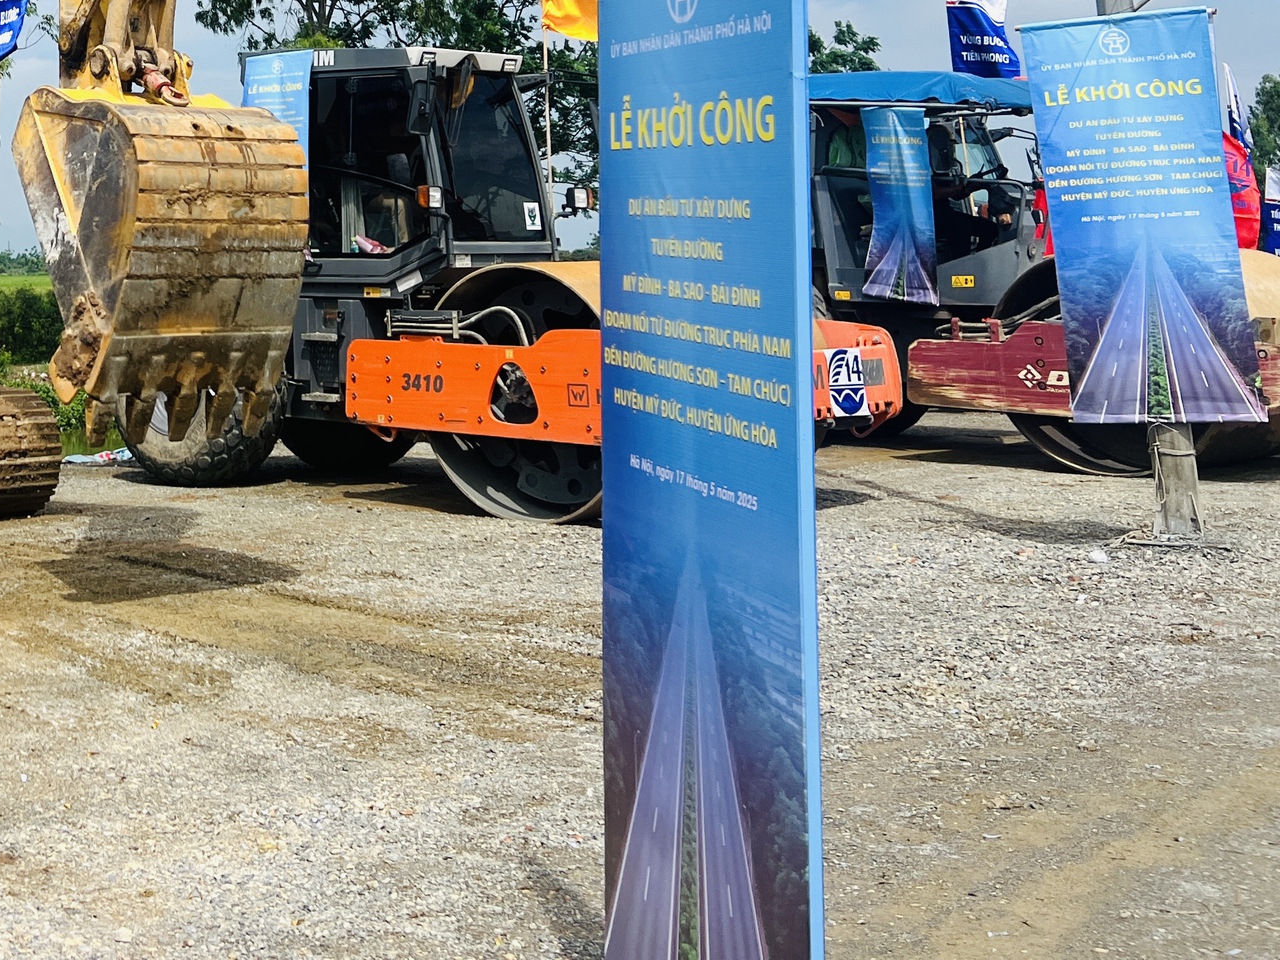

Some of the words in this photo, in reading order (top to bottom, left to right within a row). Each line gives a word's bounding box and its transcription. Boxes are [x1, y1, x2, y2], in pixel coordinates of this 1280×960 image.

[611, 39, 620, 58] ỦY
[622, 41, 638, 56] BAN
[640, 33, 661, 52] NHÂN
[664, 30, 681, 48] DÂN
[683, 25, 713, 44] THÀNH
[715, 14, 735, 39] PHỐ
[737, 14, 751, 35] HÀ
[754, 10, 771, 34] NỘI
[1054, 62, 1071, 71] BAN
[1117, 53, 1145, 64] THÀNH
[1147, 50, 1165, 61] PHỐ
[1167, 50, 1179, 60] HÀ
[1180, 50, 1197, 60] NỘI
[1044, 83, 1070, 107] LỄ
[1075, 79, 1131, 103] KHỞI
[1135, 78, 1202, 99] CÔNG
[610, 95, 632, 150] LỄ
[638, 93, 692, 148] KHỞI
[699, 91, 775, 147] CÔNG
[1113, 146, 1126, 154] BA
[1128, 144, 1147, 153] SAO
[1198, 155, 1221, 164] NAM
[1105, 174, 1141, 184] HƯƠNG
[1143, 173, 1162, 181] SƠN
[1170, 172, 1190, 180] TAM
[629, 197, 642, 220] DỰ
[644, 196, 656, 216] ÁN
[658, 194, 678, 217] ĐẦU
[679, 197, 694, 217] TƯ
[696, 196, 715, 218] XÂY
[718, 197, 751, 224] DỰNG
[1061, 192, 1092, 202] HUYỆN
[684, 237, 723, 261] ĐƯỜNG
[623, 272, 637, 292] MỸ
[638, 273, 662, 295] ĐÌNH
[668, 279, 681, 298] BA
[683, 281, 704, 301] SAO
[731, 283, 761, 309] ĐÍNH
[604, 308, 631, 333] (ĐOẠN
[633, 310, 649, 333] NỐI
[650, 315, 663, 335] TỪ
[665, 319, 702, 343] ĐƯỜNG
[703, 326, 731, 352] TRỤC
[733, 329, 760, 353] PHÍA
[762, 335, 791, 359] NAM
[402, 373, 444, 393] 3410
[604, 343, 621, 366] ĐẾN
[623, 351, 656, 375] ĐƯỜNG
[658, 358, 694, 383] HƯƠNG
[696, 367, 718, 389] SƠN
[727, 373, 751, 397] TAM
[754, 378, 791, 408] CHÚC)
[845, 355, 863, 382] 14
[614, 387, 644, 414] HUYỆN
[645, 393, 659, 415] MỸ
[661, 399, 685, 425] ĐỨC,
[686, 406, 722, 436] HUYỆN
[724, 413, 749, 441] ỨNG
[751, 421, 778, 450] HÒA
[630, 453, 640, 469] Hà
[641, 458, 655, 476] Nội,
[655, 465, 675, 484] ngày
[676, 469, 685, 485] 17
[686, 474, 708, 497] tháng
[709, 481, 715, 496] 5
[716, 485, 735, 503] năm
[737, 491, 758, 511] 2025
